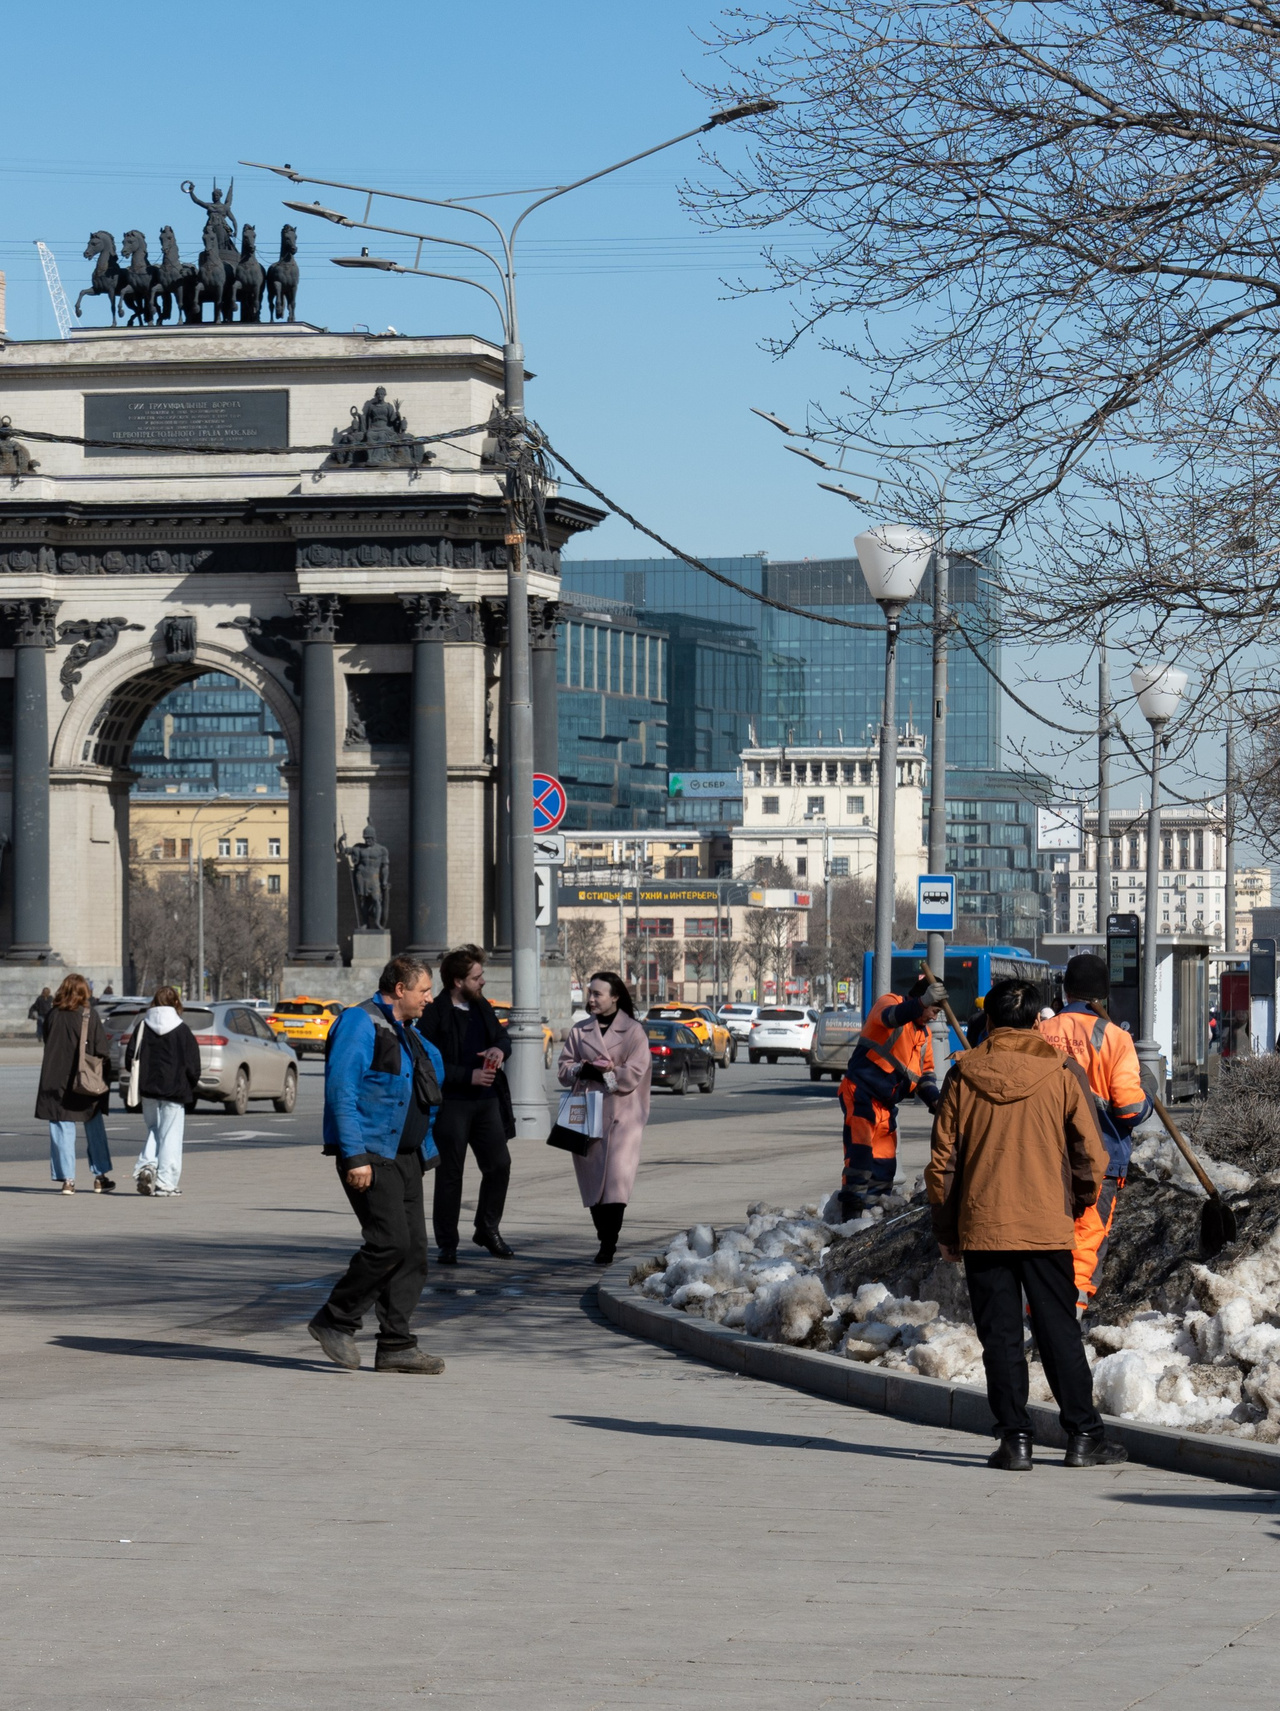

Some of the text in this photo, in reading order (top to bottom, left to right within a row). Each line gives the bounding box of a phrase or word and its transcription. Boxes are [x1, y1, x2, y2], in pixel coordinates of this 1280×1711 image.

[149, 402, 207, 410] ТРИУМФАЛЬНЫЕ
[212, 401, 241, 409] ВОРОТА
[113, 430, 195, 438] ПЕРВОПРЕСТОЛЬНОГО
[224, 429, 257, 437] МОСКВЫ
[702, 781, 725, 789] СБЕР
[638, 892, 663, 900] УХНИ
[825, 1020, 842, 1028] ПОЧТА
